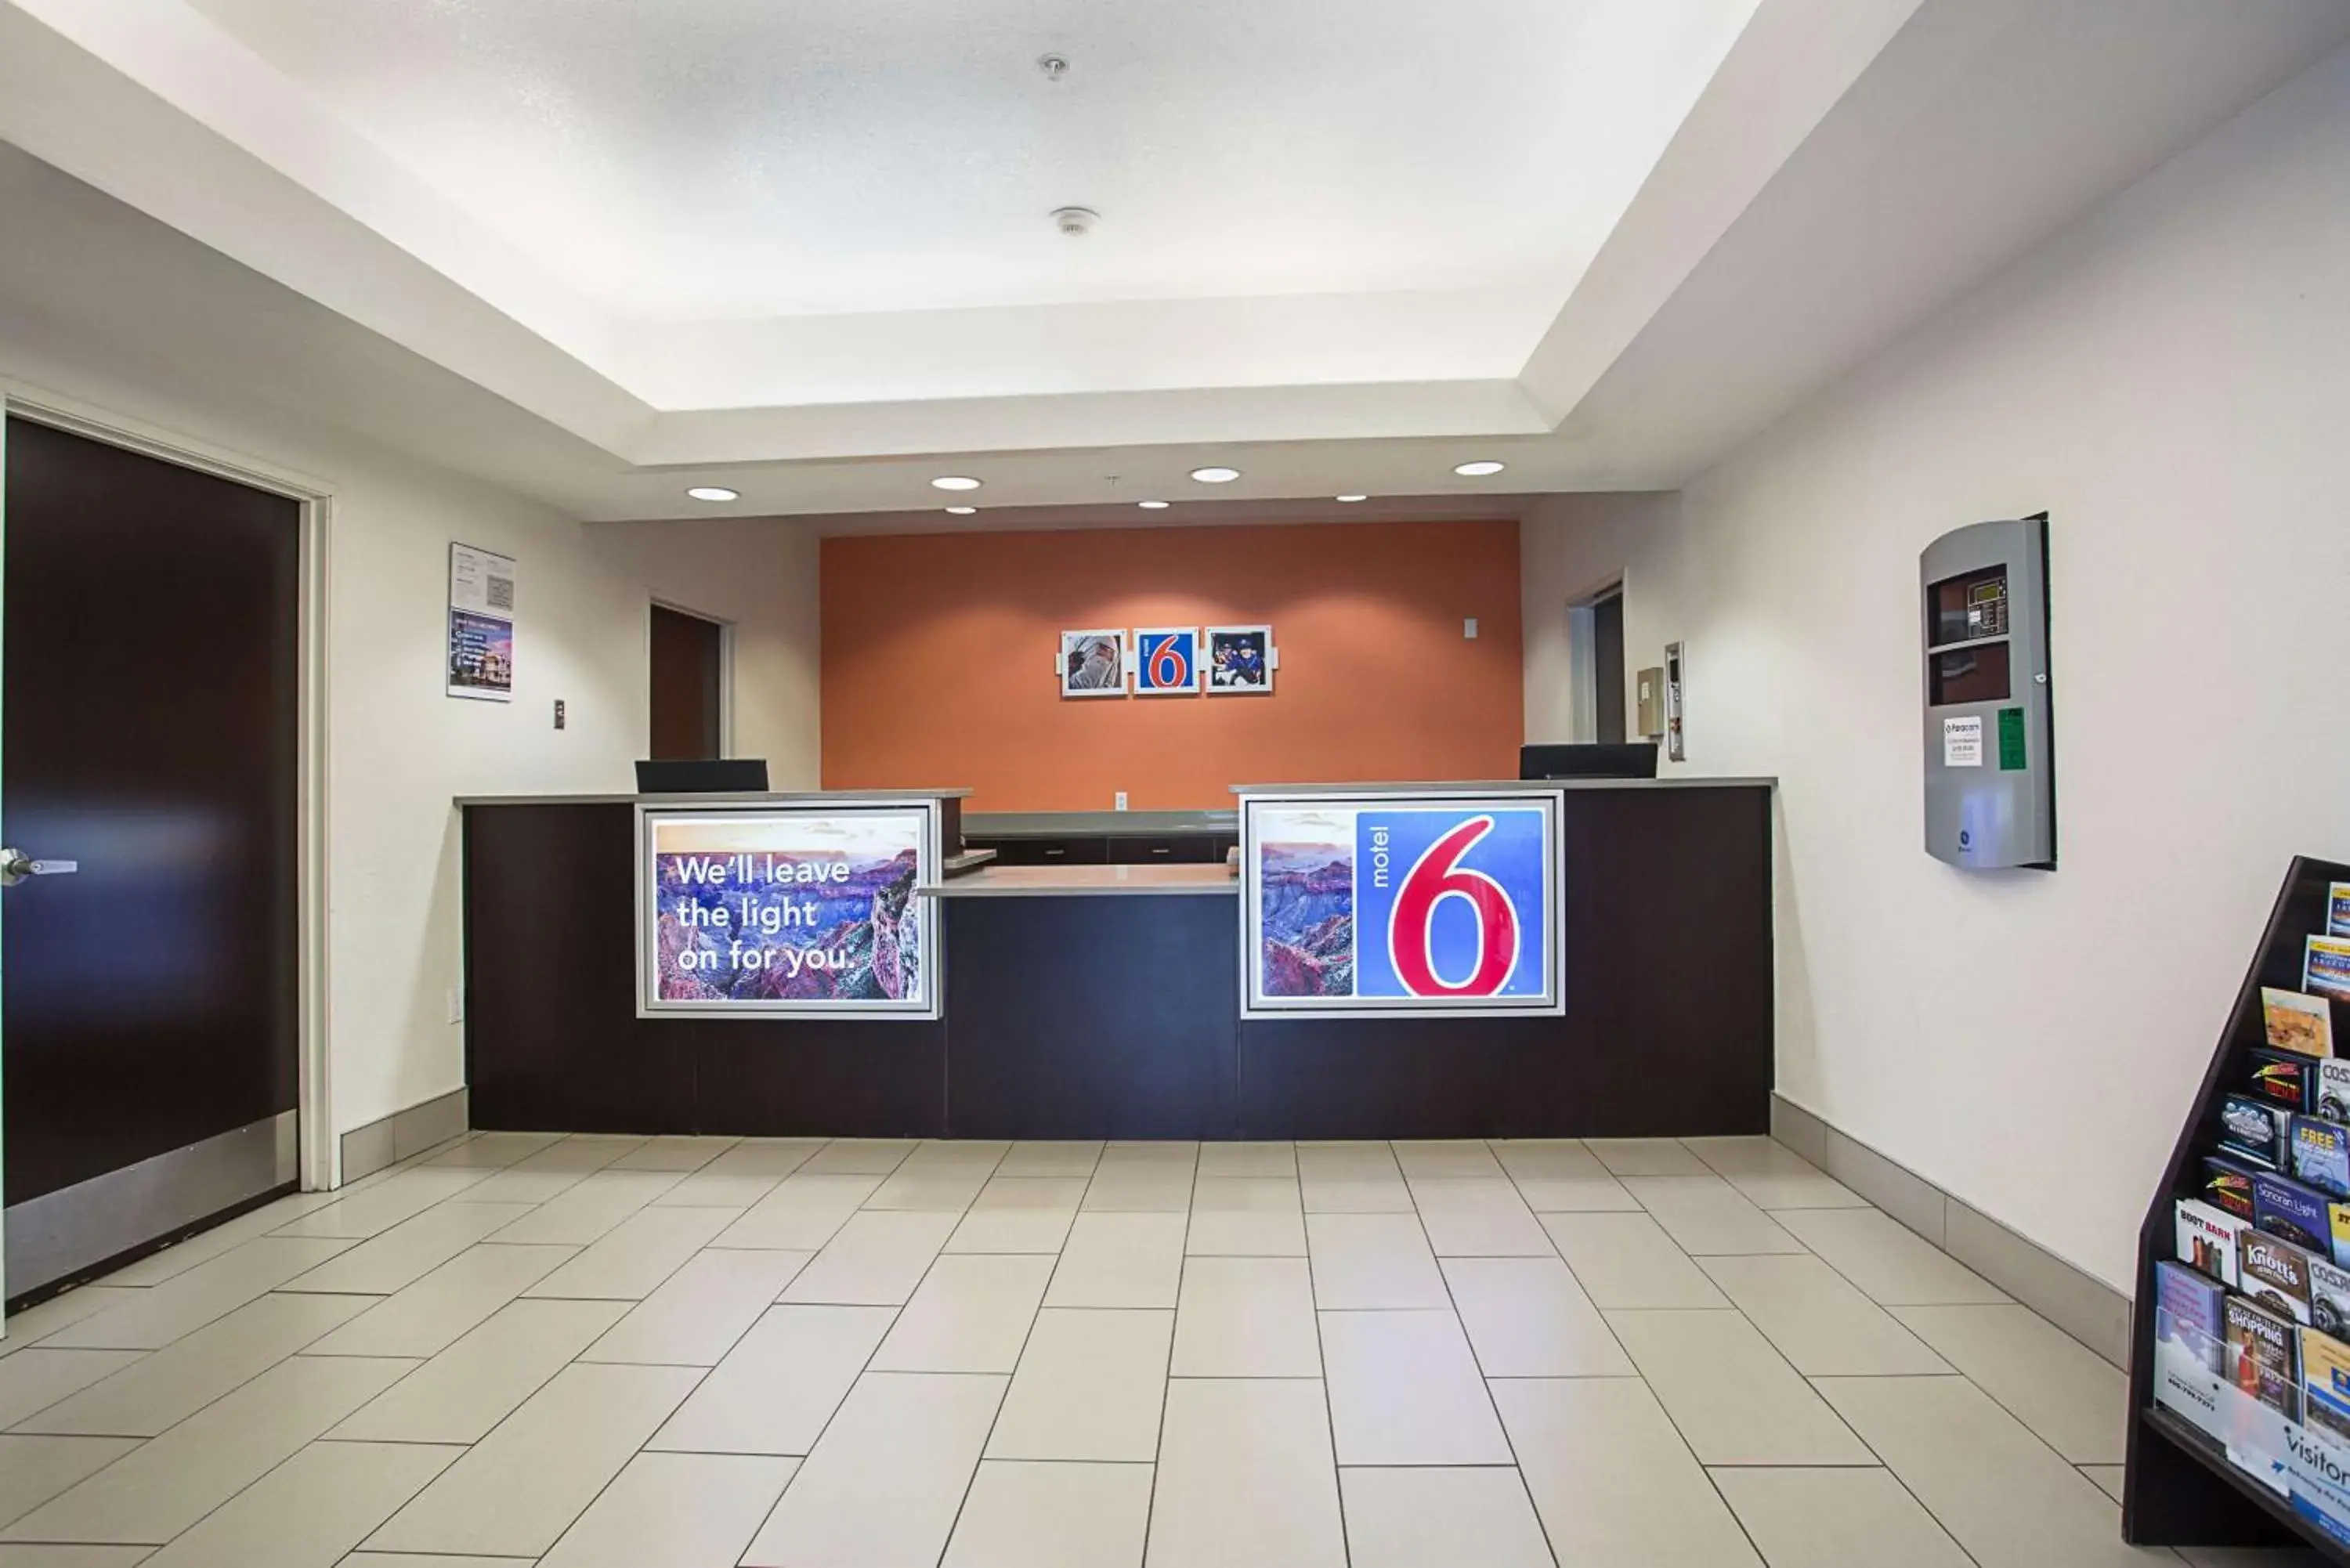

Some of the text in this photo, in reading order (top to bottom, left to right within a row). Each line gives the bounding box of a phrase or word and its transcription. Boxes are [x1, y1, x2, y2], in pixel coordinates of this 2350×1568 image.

[1148, 635, 1187, 689] 6
[676, 854, 850, 884] We’ll leave
[677, 898, 817, 934] the light
[1369, 814, 1520, 997] motel 6
[678, 940, 855, 978] on for you.
[2300, 1127, 2335, 1149] FREE
[2180, 1209, 2230, 1241] BOOT BARN
[2247, 1244, 2299, 1286] Knott's
[2229, 1310, 2283, 1347] SHOPPING
